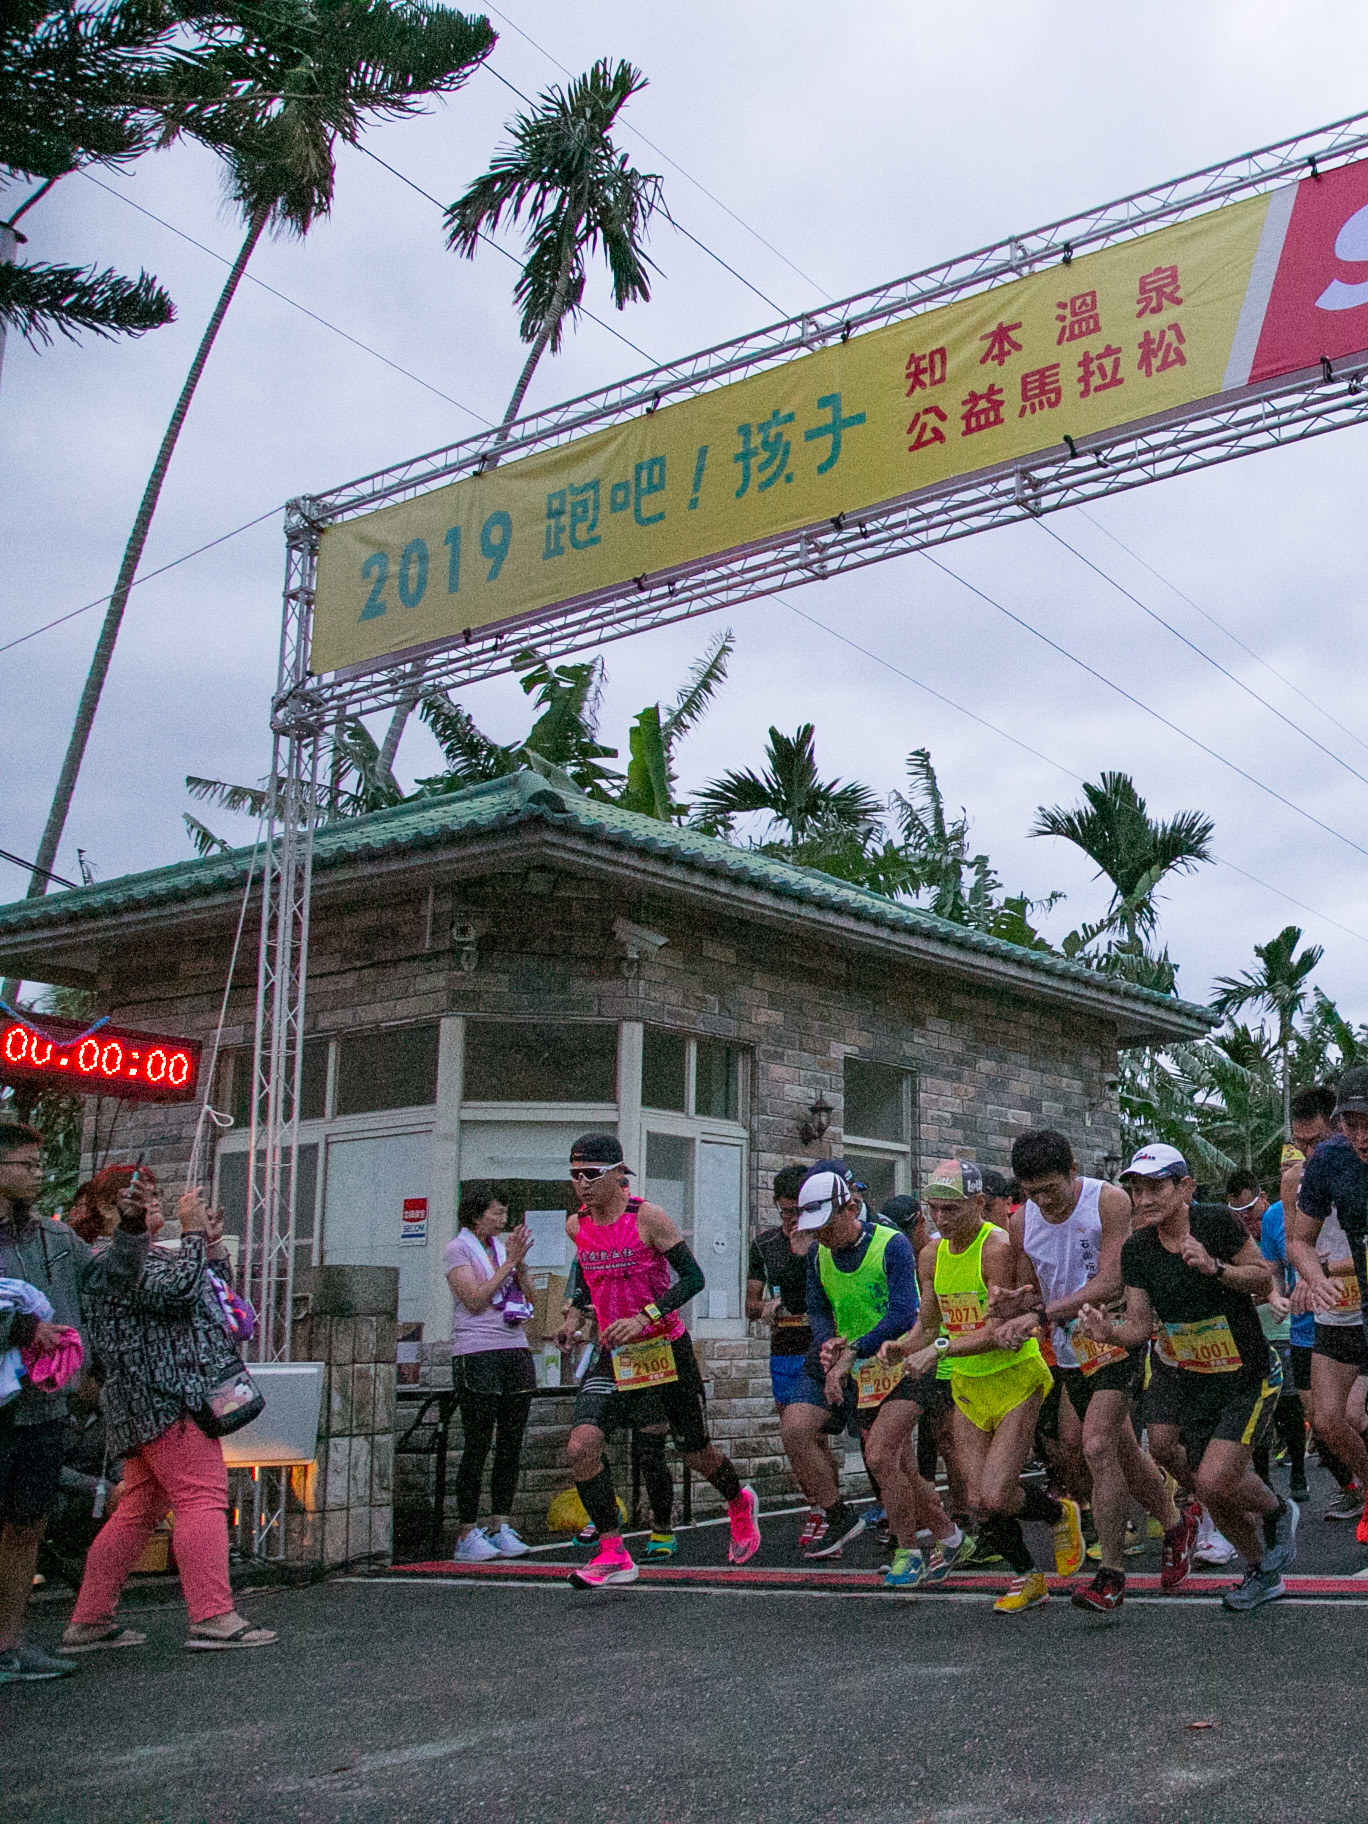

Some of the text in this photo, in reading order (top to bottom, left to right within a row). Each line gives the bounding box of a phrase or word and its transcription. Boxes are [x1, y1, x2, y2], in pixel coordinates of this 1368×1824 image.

[904, 264, 1184, 397] 知本溫泉
[905, 323, 1188, 453] 公益馬拉松
[357, 508, 514, 623] 2019
[634, 1356, 670, 1377] 2100
[949, 1306, 979, 1323] 2071
